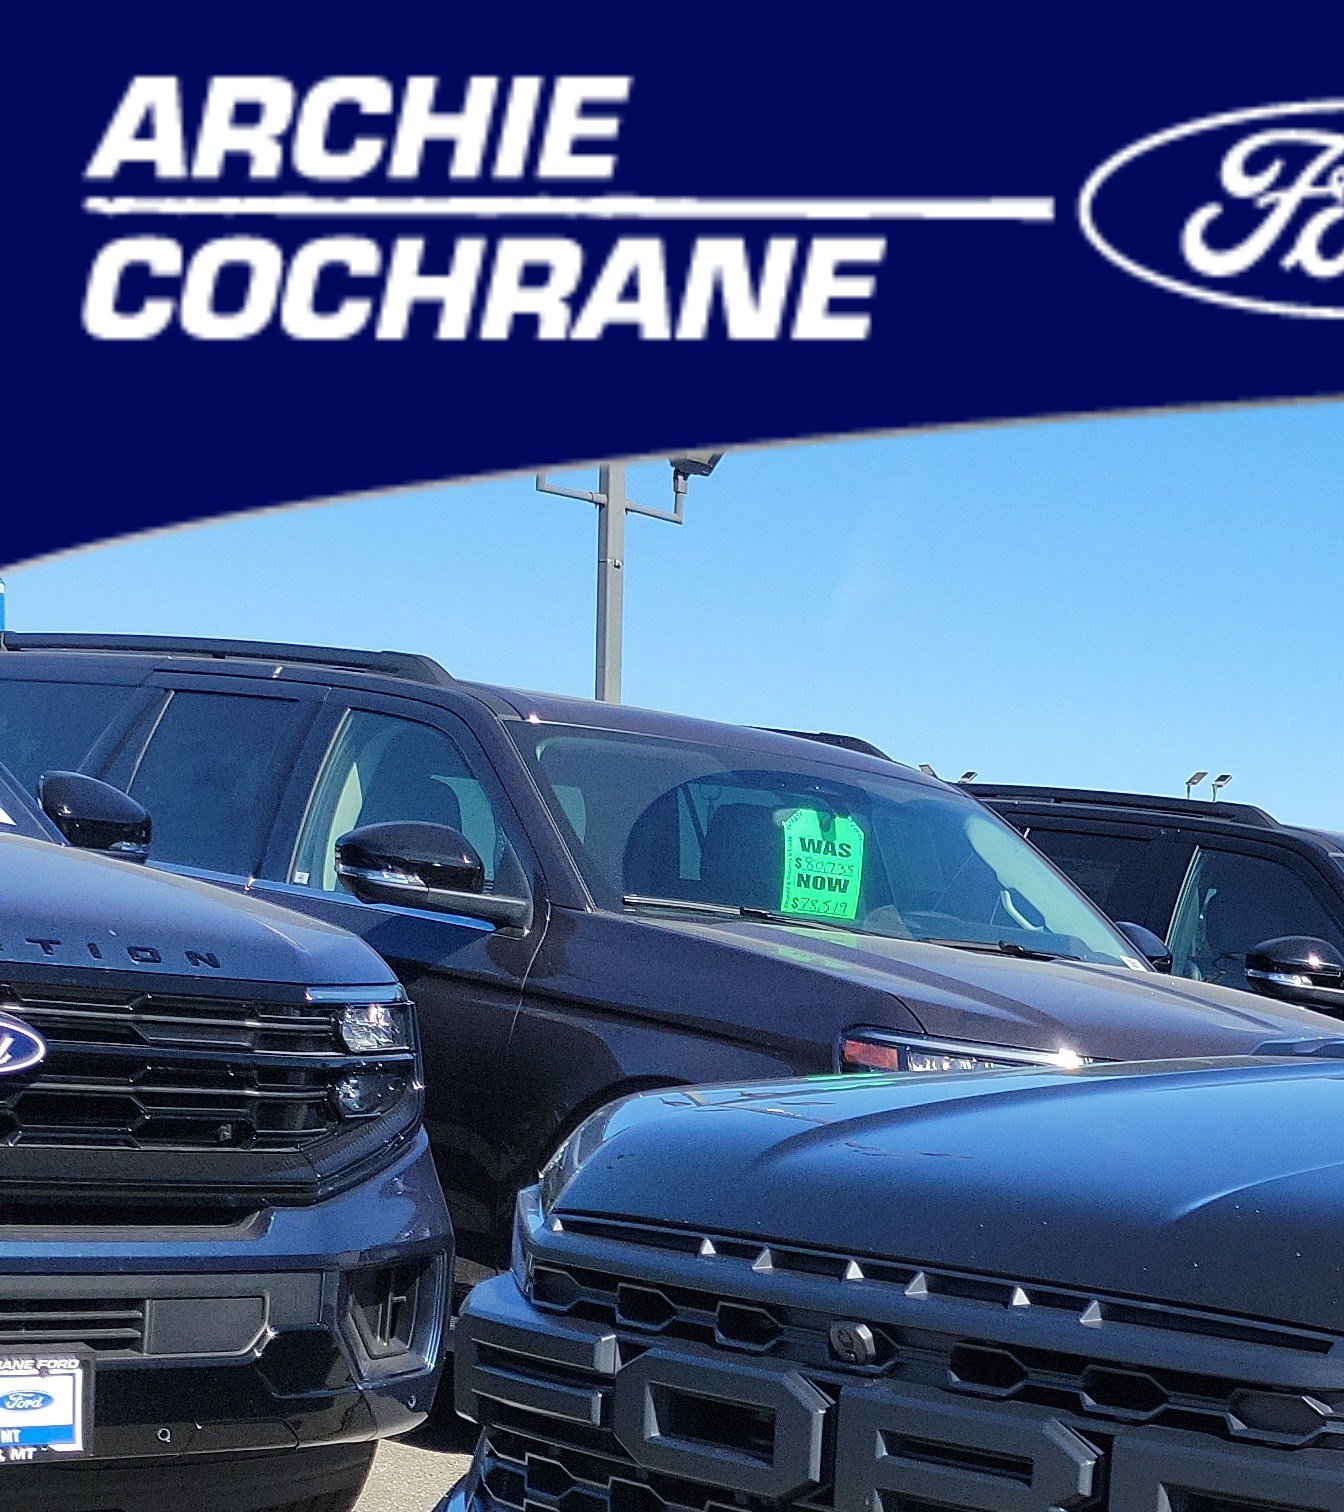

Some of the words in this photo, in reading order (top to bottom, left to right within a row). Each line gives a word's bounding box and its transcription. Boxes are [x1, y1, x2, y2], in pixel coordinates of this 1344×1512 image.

[799, 837, 852, 858] WAS
[796, 873, 850, 893] NOW
[0, 1359, 36, 1370] ANE
[36, 1358, 80, 1370] FORD
[4, 1392, 45, 1409] Ford
[0, 1429, 21, 1444] MT
[10, 1446, 38, 1461] MT
